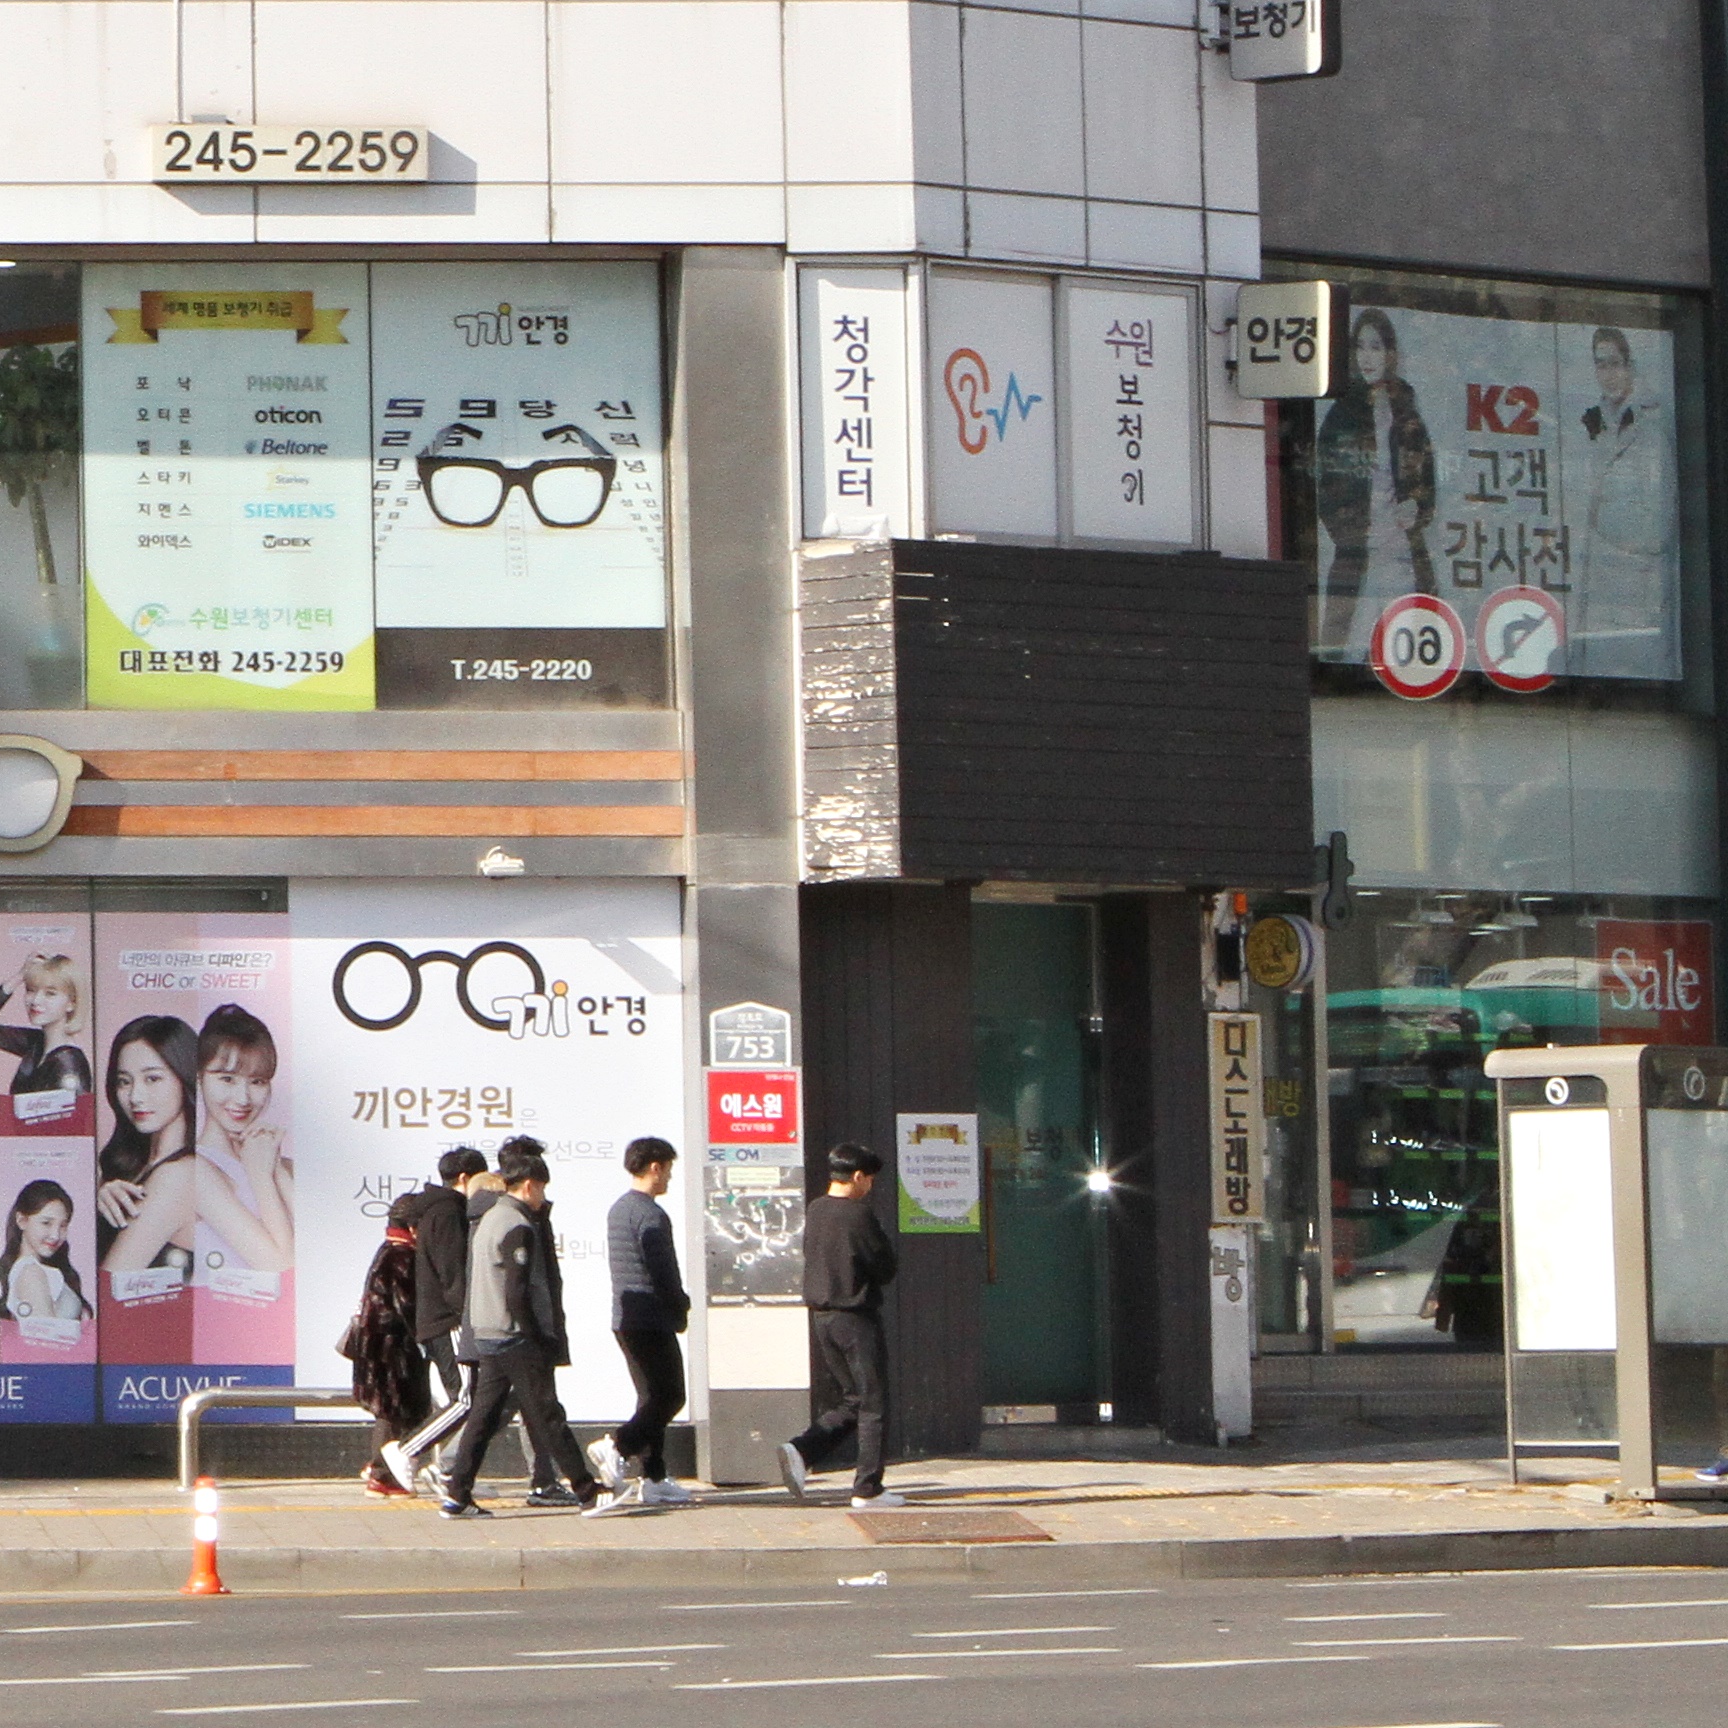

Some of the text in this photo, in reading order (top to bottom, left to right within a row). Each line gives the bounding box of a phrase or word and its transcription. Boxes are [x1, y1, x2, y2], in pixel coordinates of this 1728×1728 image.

[1234, 1, 1316, 40] 보청기
[164, 129, 420, 174] 245-2259
[517, 314, 570, 346] 안경
[1104, 318, 1154, 368] 수원
[1246, 315, 1318, 365] 안경
[246, 375, 329, 392] PHONAK
[254, 405, 323, 424] oticon
[831, 313, 875, 509] 청각센터
[1466, 383, 1541, 436] K2
[260, 437, 329, 456] Beltone
[1463, 449, 1550, 516] 고객
[245, 502, 337, 519] SIEMENS
[1444, 520, 1572, 592] 감사전
[188, 605, 334, 631] 수원보청기센터
[119, 648, 345, 675] 대표전화 245-2259
[450, 658, 593, 681] T.245-2220
[130, 972, 262, 989] CHIC or SWEET
[1610, 946, 1702, 1012] Sale
[577, 996, 648, 1036] 안경
[726, 1035, 775, 1060] 753
[719, 1093, 783, 1119] 에스원
